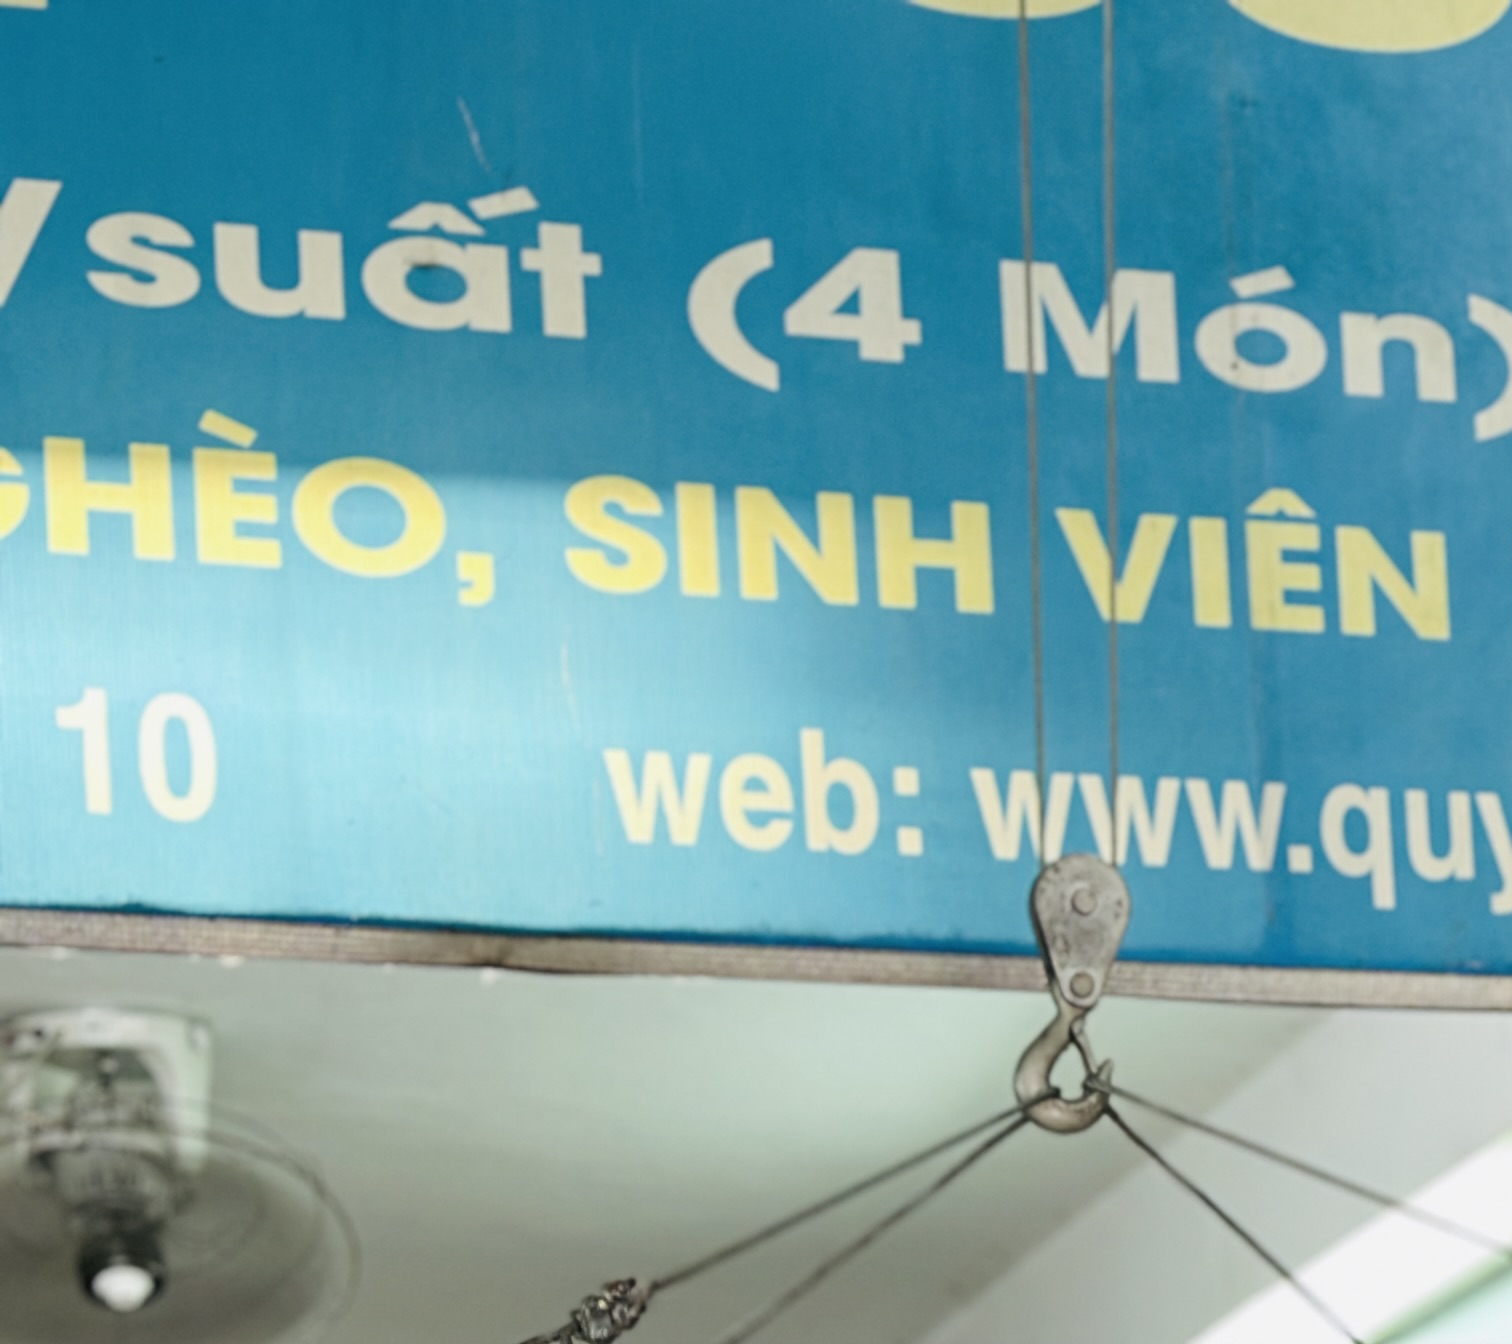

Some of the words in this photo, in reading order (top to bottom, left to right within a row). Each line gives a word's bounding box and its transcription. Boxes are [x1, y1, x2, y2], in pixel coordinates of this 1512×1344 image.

[687, 238, 922, 392] (4
[0, 408, 495, 607] HÈO,
[563, 474, 994, 616] SINH
[1054, 487, 1452, 642] VIÊN
[54, 686, 218, 824] 10
[602, 727, 924, 857] web:
